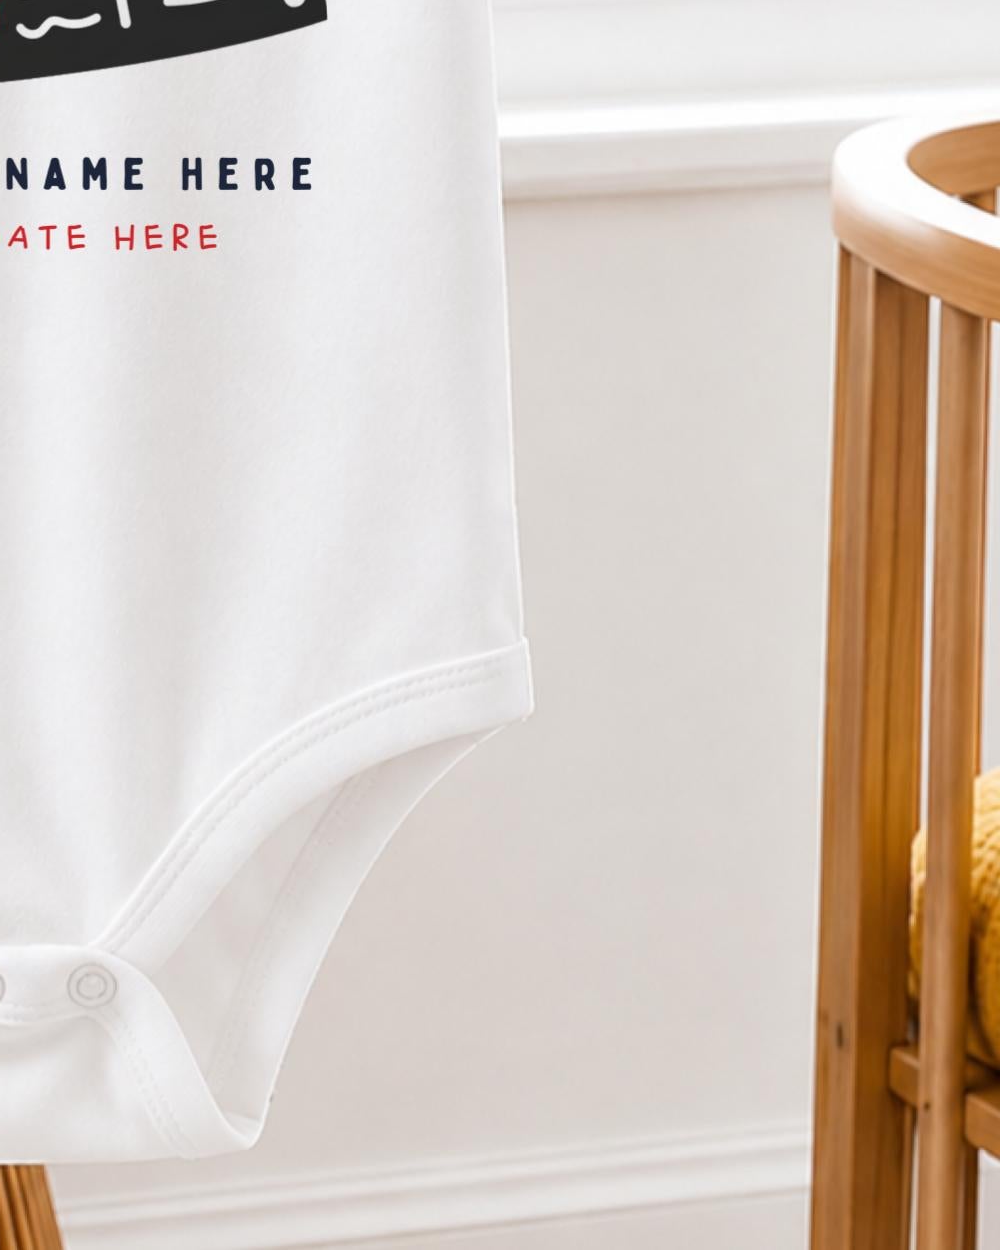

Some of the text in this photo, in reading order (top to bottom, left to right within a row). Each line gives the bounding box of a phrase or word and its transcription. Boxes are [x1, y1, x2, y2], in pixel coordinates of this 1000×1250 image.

[5, 156, 145, 192] NAME
[181, 156, 313, 192] HERE
[114, 223, 219, 252] HERE
